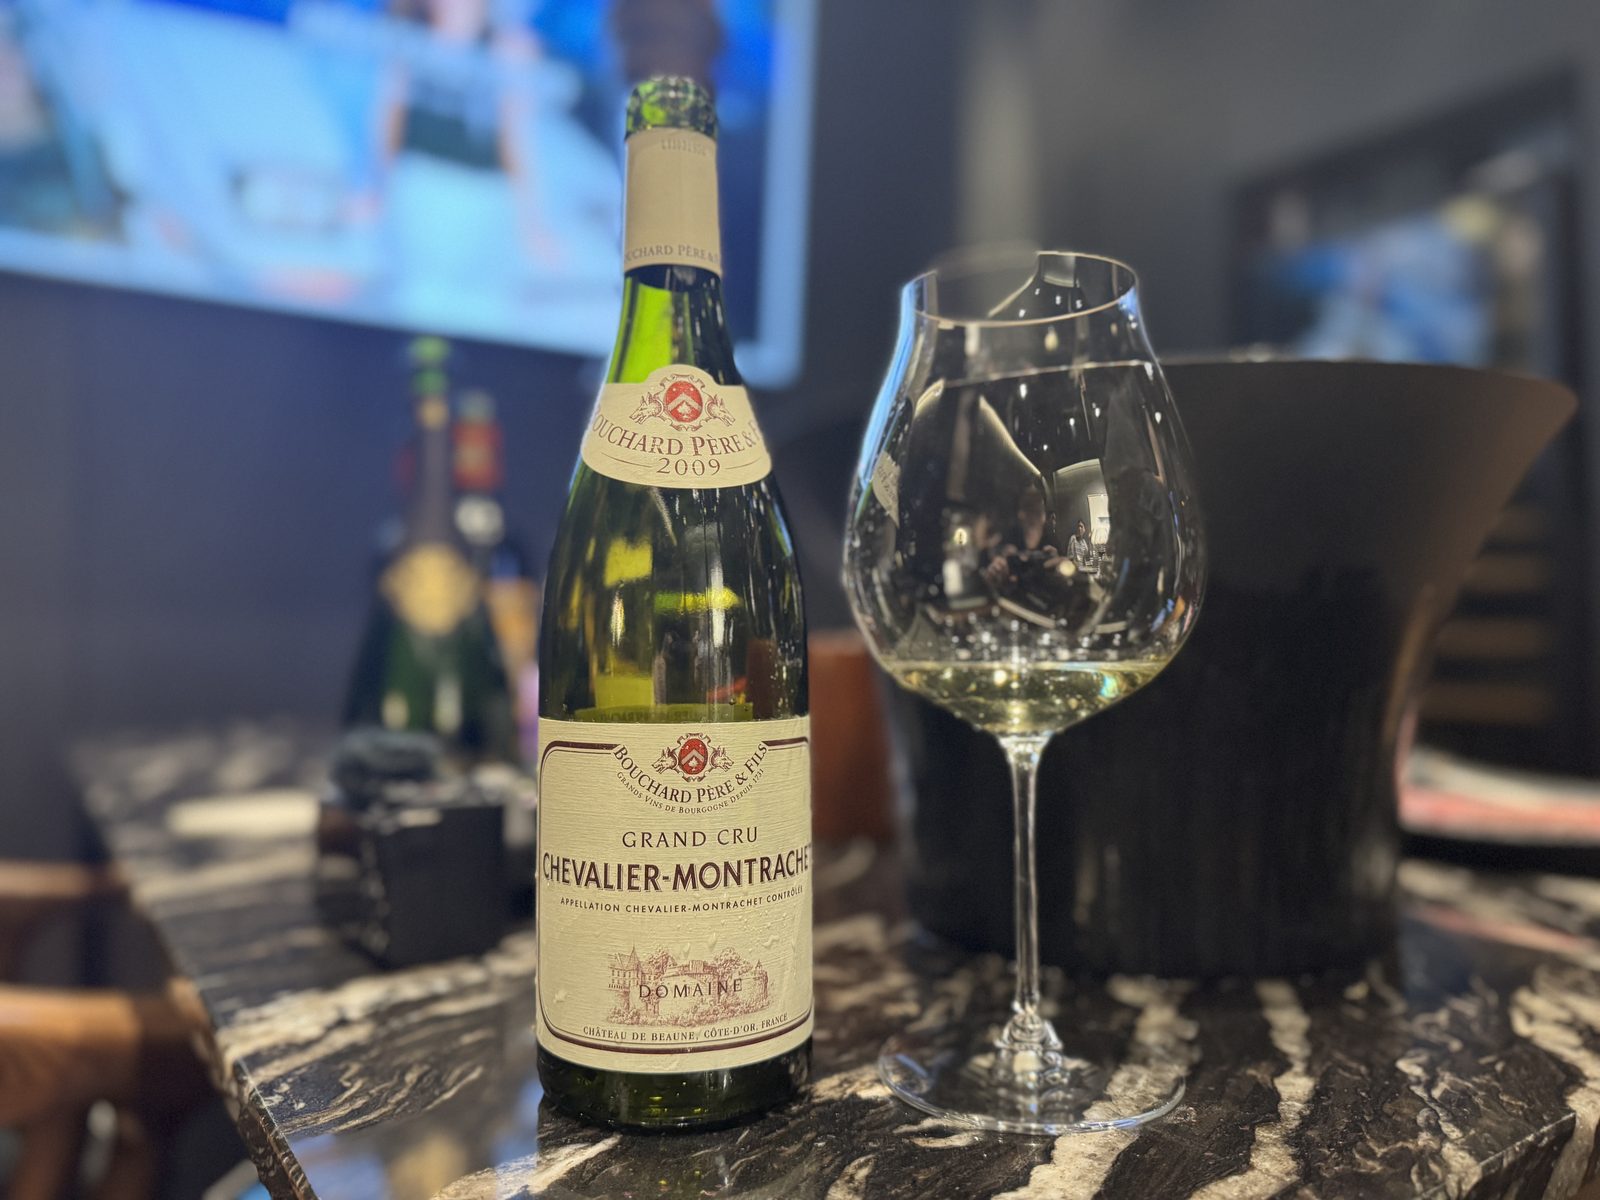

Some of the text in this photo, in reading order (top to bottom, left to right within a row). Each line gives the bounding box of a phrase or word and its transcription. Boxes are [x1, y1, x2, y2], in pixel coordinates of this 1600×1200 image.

[691, 434, 745, 456] PÈRE
[742, 431, 756, 447] &
[656, 457, 721, 476] 2009
[613, 744, 768, 803] BOUCHARD PÈRE & FILS
[617, 772, 643, 798] GRANDS
[645, 796, 663, 809] VINS
[679, 801, 728, 814] BOURGOGNE
[730, 784, 753, 803] DEPUIS
[752, 769, 764, 783] 1731
[622, 827, 758, 848] GRAND CRU
[560, 897, 620, 912] APPELLATION
[625, 896, 763, 912] CHEVALIER-MONTRACHET
[639, 979, 742, 998] DOMAINE
[583, 1026, 627, 1040] CHÂTEAU
[632, 1032, 646, 1040] DE
[652, 1031, 699, 1041] BEAUNE,
[761, 1013, 788, 1028] FRANCE
